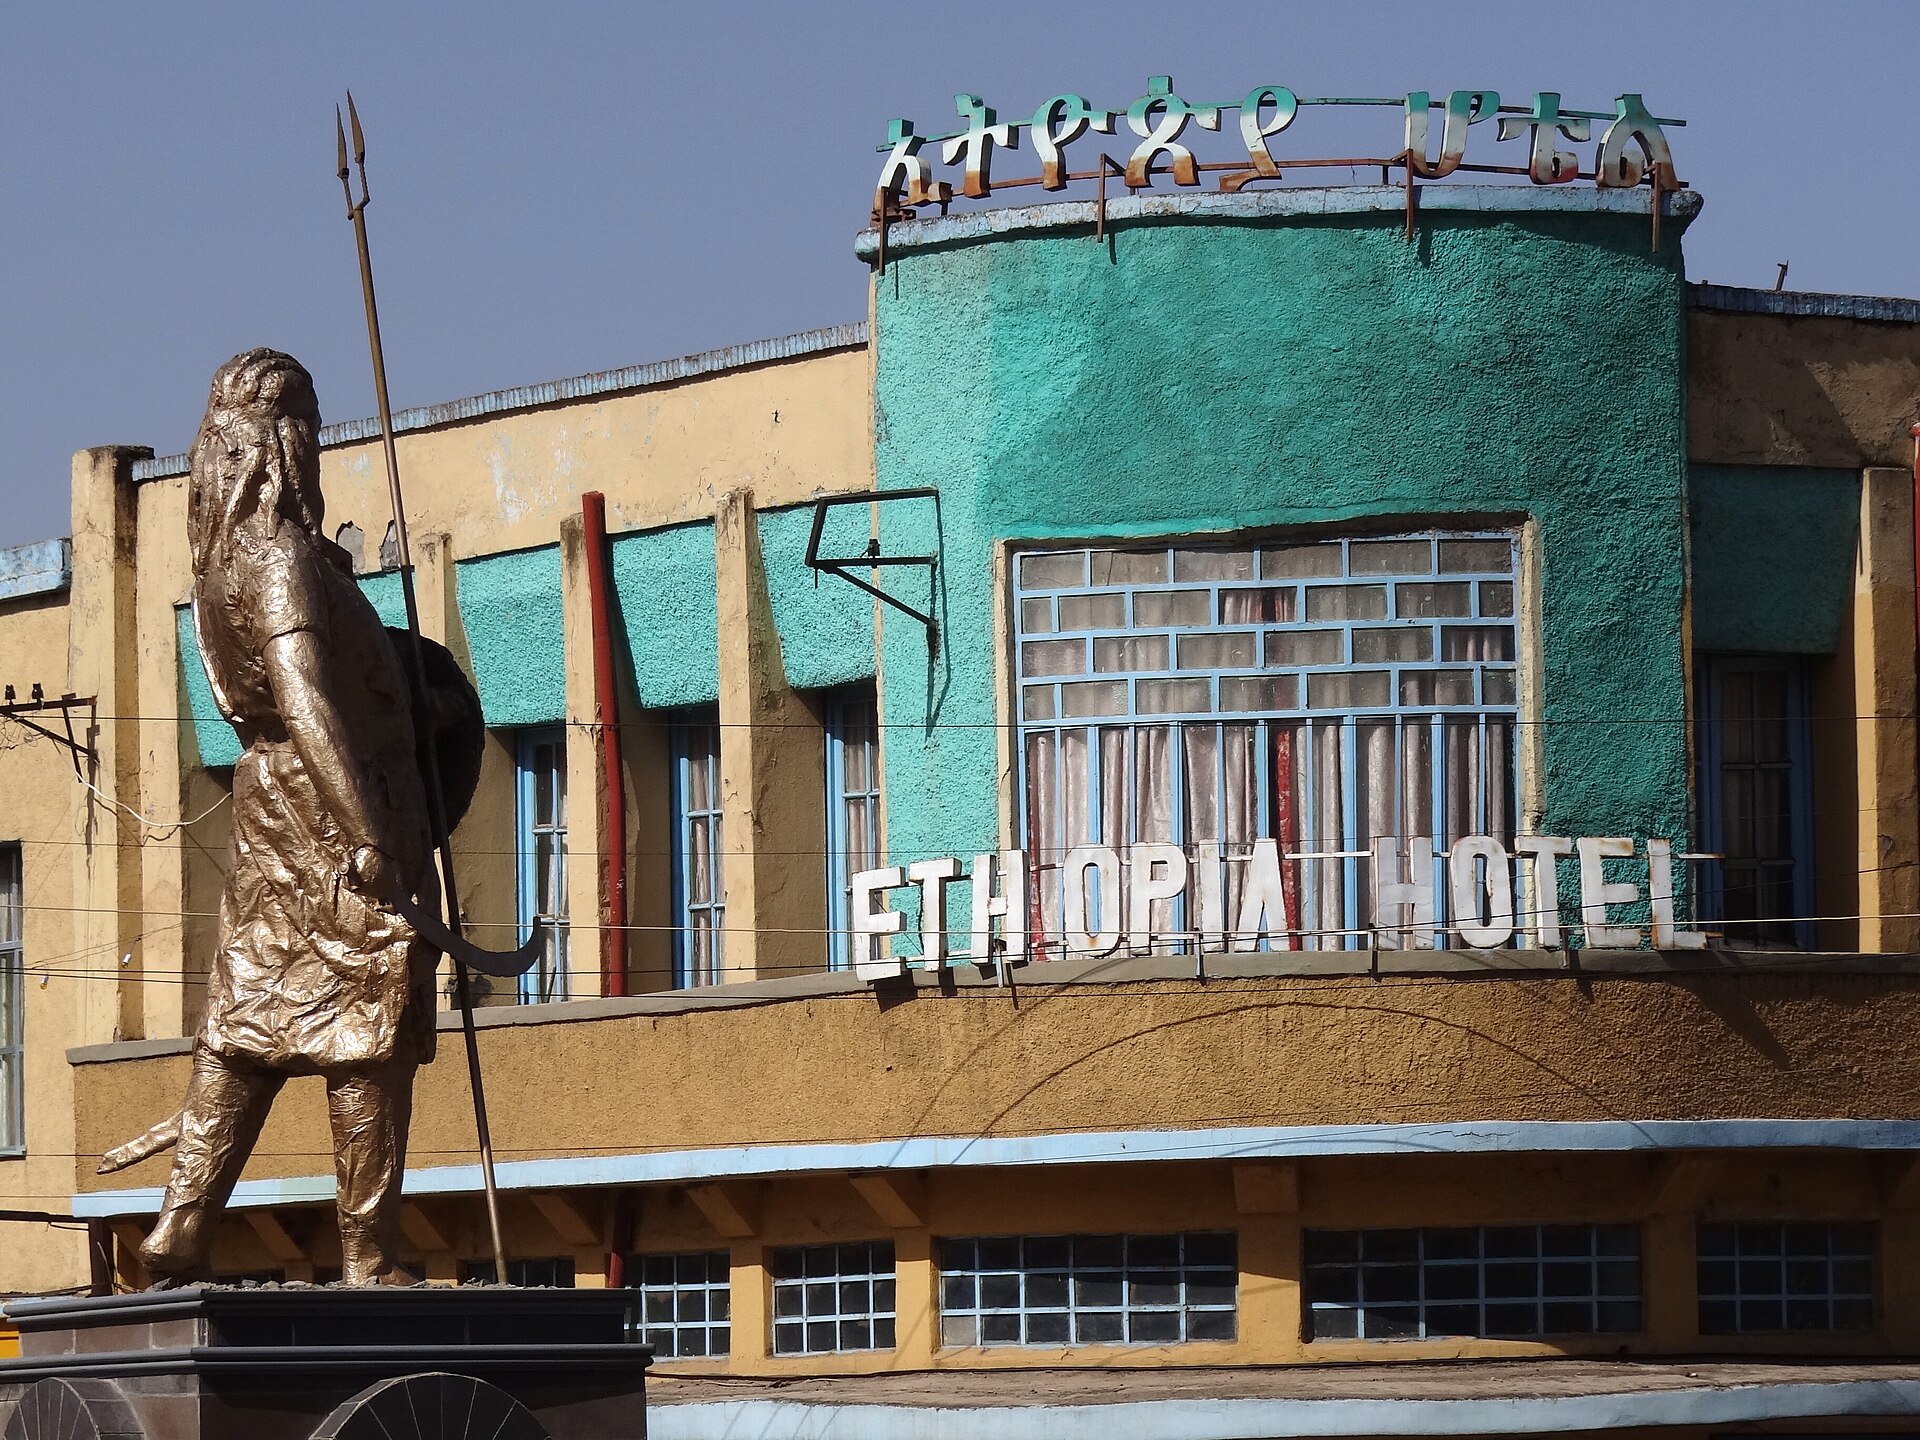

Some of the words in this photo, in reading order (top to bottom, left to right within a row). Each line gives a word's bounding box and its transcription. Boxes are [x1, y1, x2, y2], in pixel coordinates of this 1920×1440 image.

[870, 75, 1298, 227] ኢትዮጵያ
[1404, 90, 1680, 192] ሆቴል
[1373, 835, 1708, 951] HOTEL
